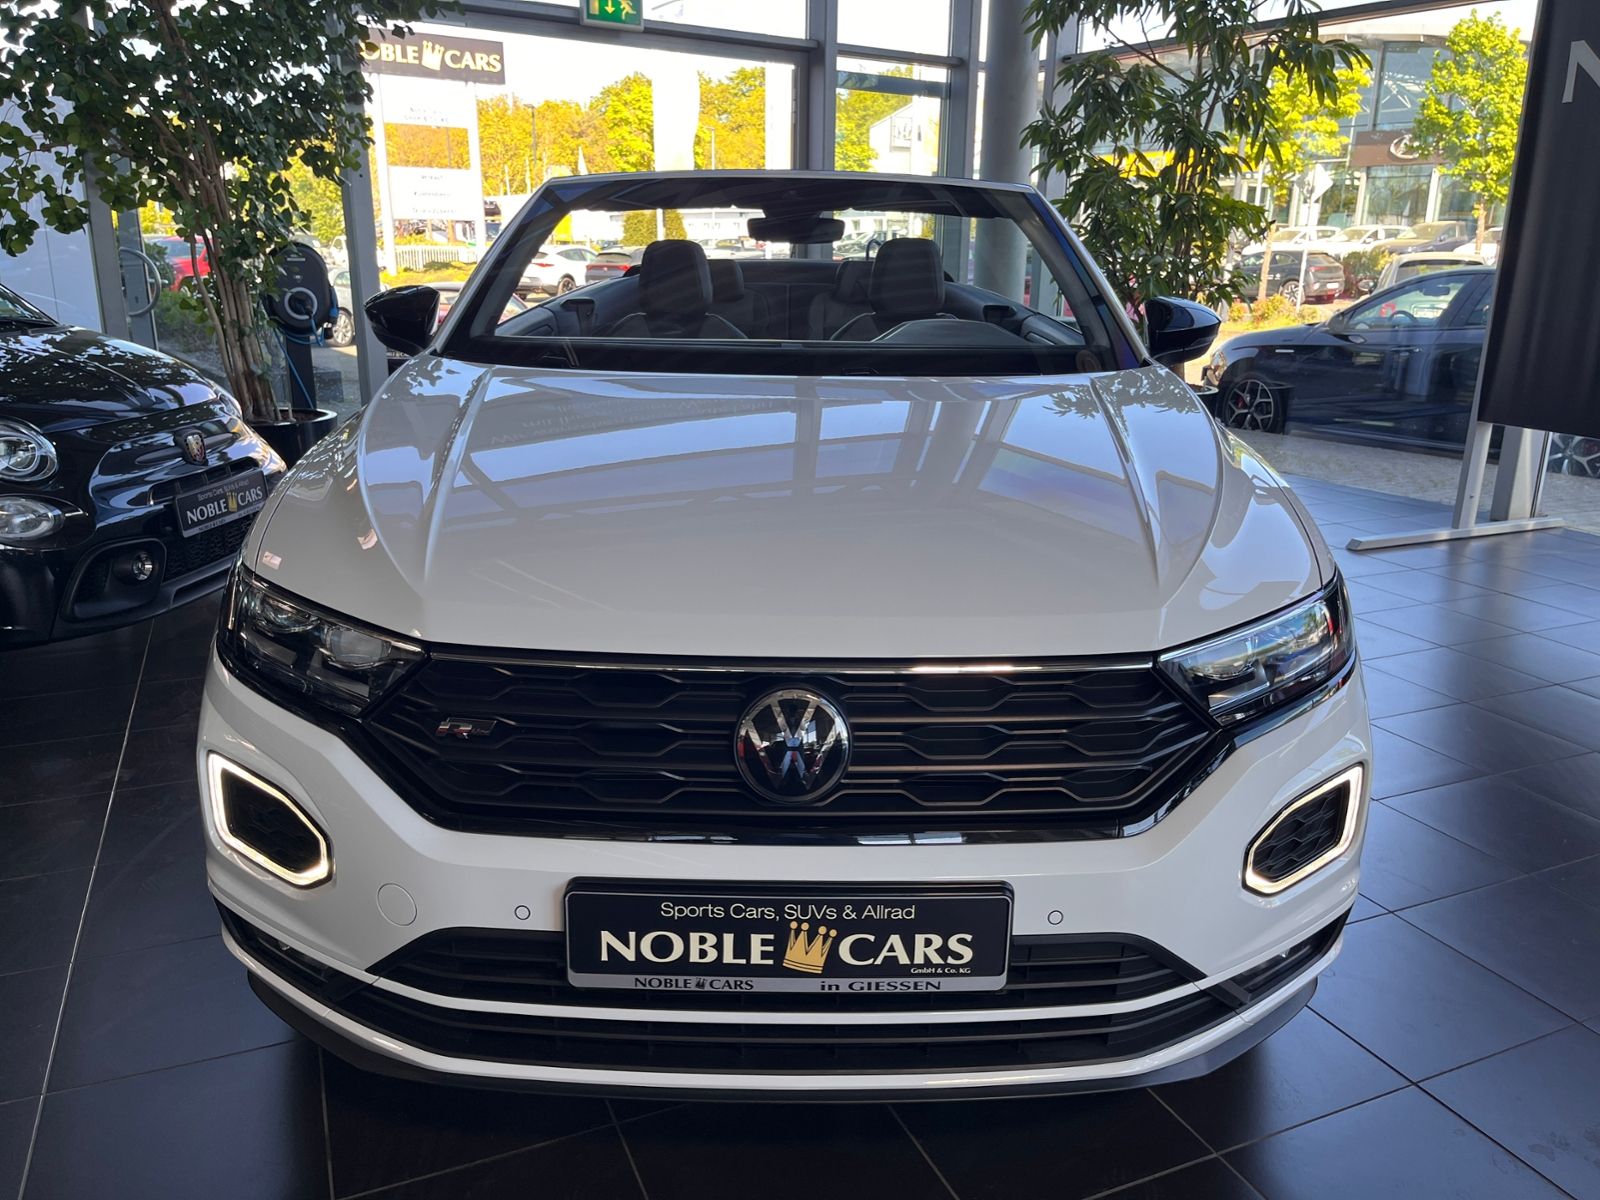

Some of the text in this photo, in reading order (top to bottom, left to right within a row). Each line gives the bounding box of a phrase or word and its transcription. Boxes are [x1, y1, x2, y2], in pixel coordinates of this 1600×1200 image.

[360, 42, 502, 73] OBLE CARS
[186, 499, 228, 524] NOBLE
[237, 486, 263, 506] CARS
[660, 902, 916, 921] Sports Cars, SUVs & Allrad
[600, 930, 974, 966] NOBLE CARS
[634, 977, 754, 991] NOBLE CARS
[820, 980, 942, 991] in GIESSEN
